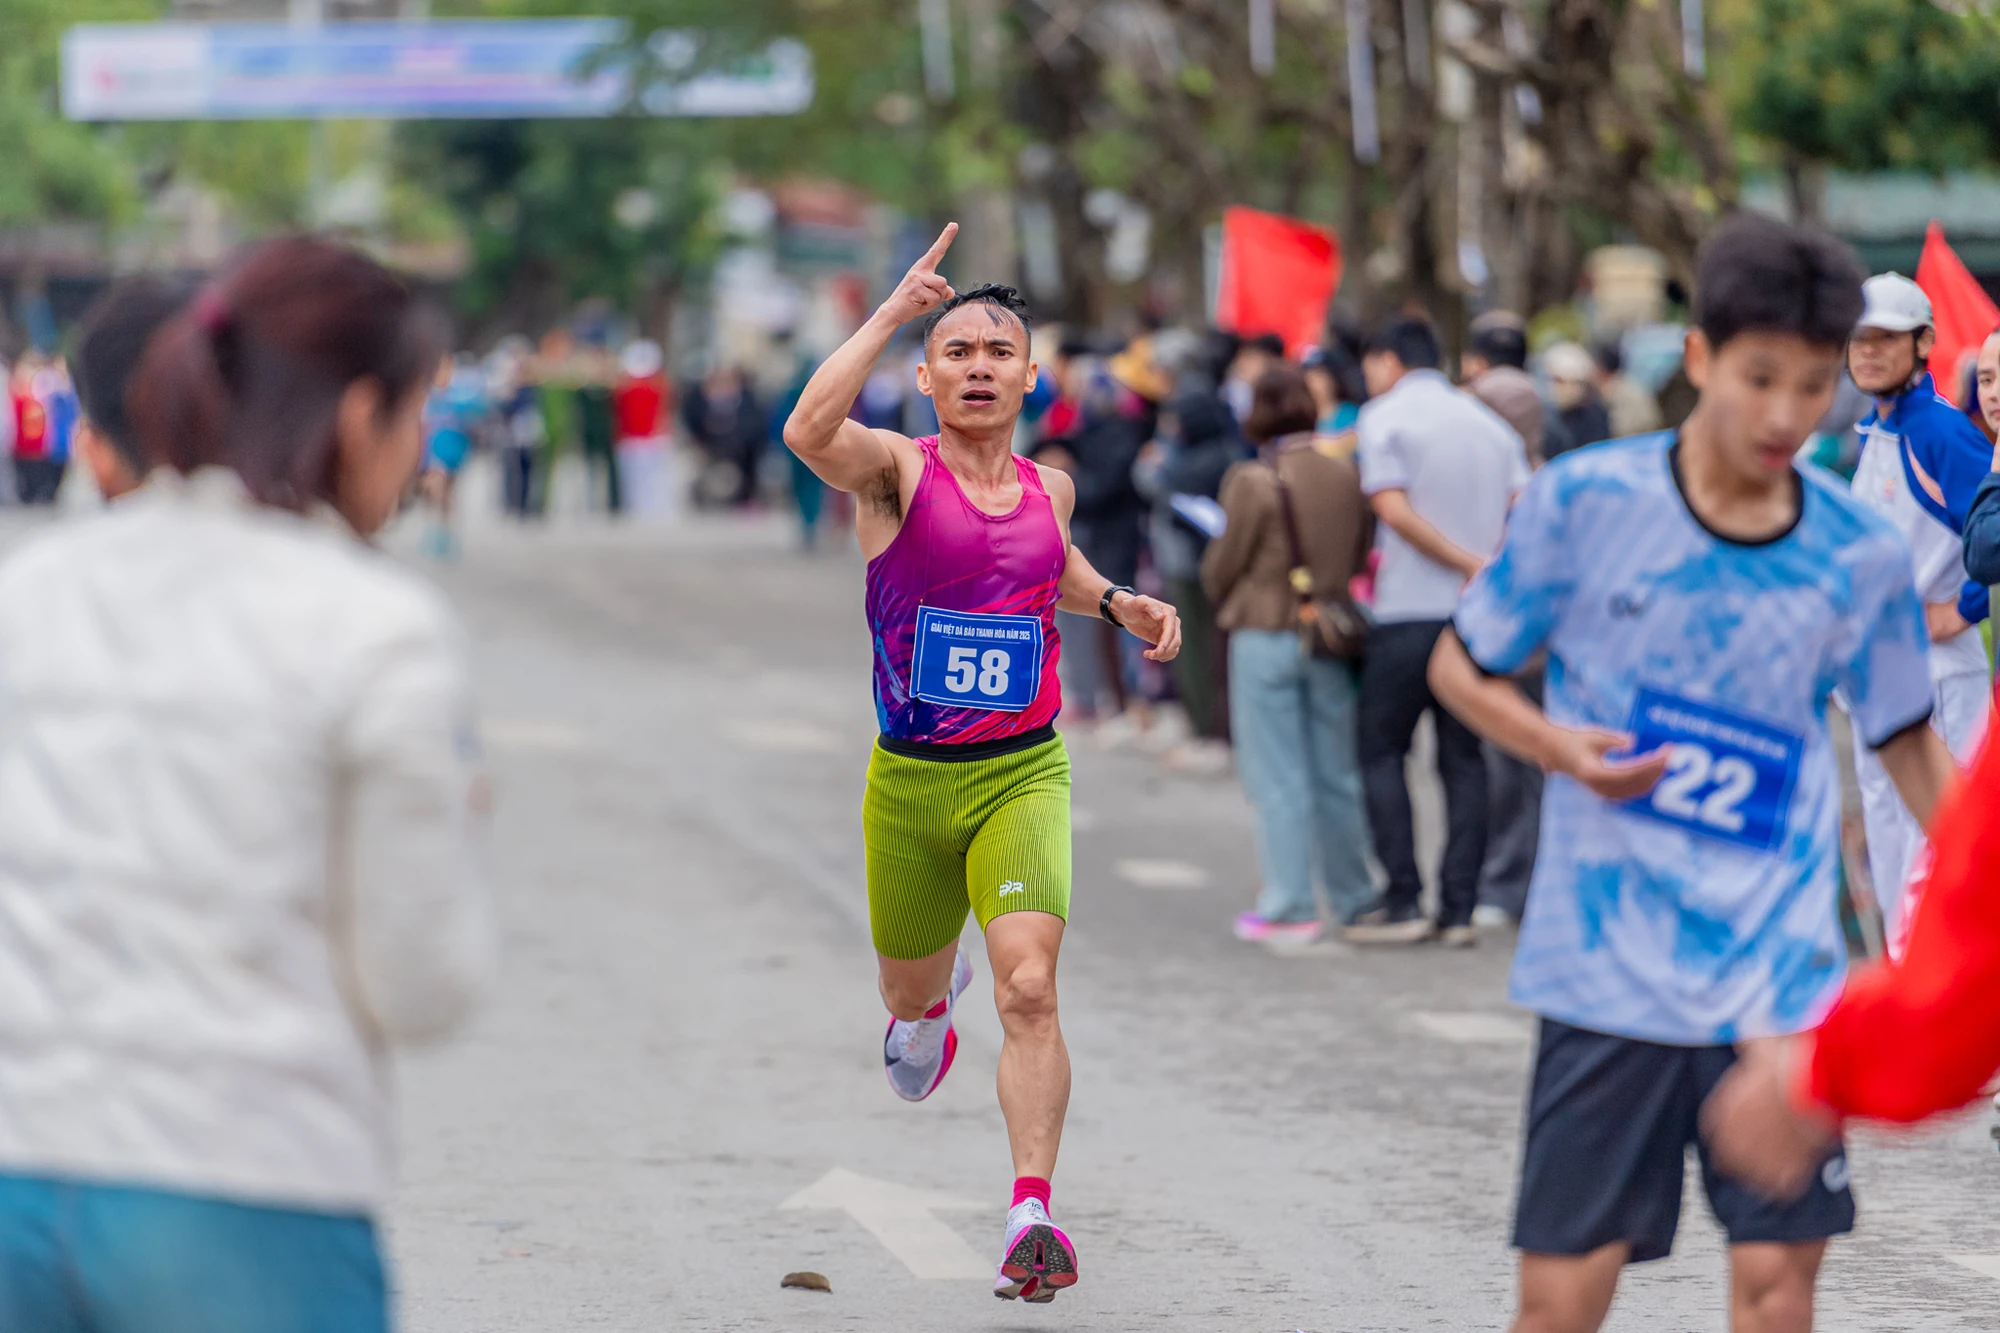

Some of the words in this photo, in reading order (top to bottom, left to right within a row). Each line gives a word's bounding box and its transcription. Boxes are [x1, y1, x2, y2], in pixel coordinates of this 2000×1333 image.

[943, 623, 955, 637] VIỆT
[964, 625, 976, 637] BÁO
[976, 627, 994, 638] THANH
[1006, 628, 1019, 640] NĂM
[1019, 630, 1031, 640] 2025
[944, 646, 1011, 696] 58
[1651, 742, 1757, 833] 22
